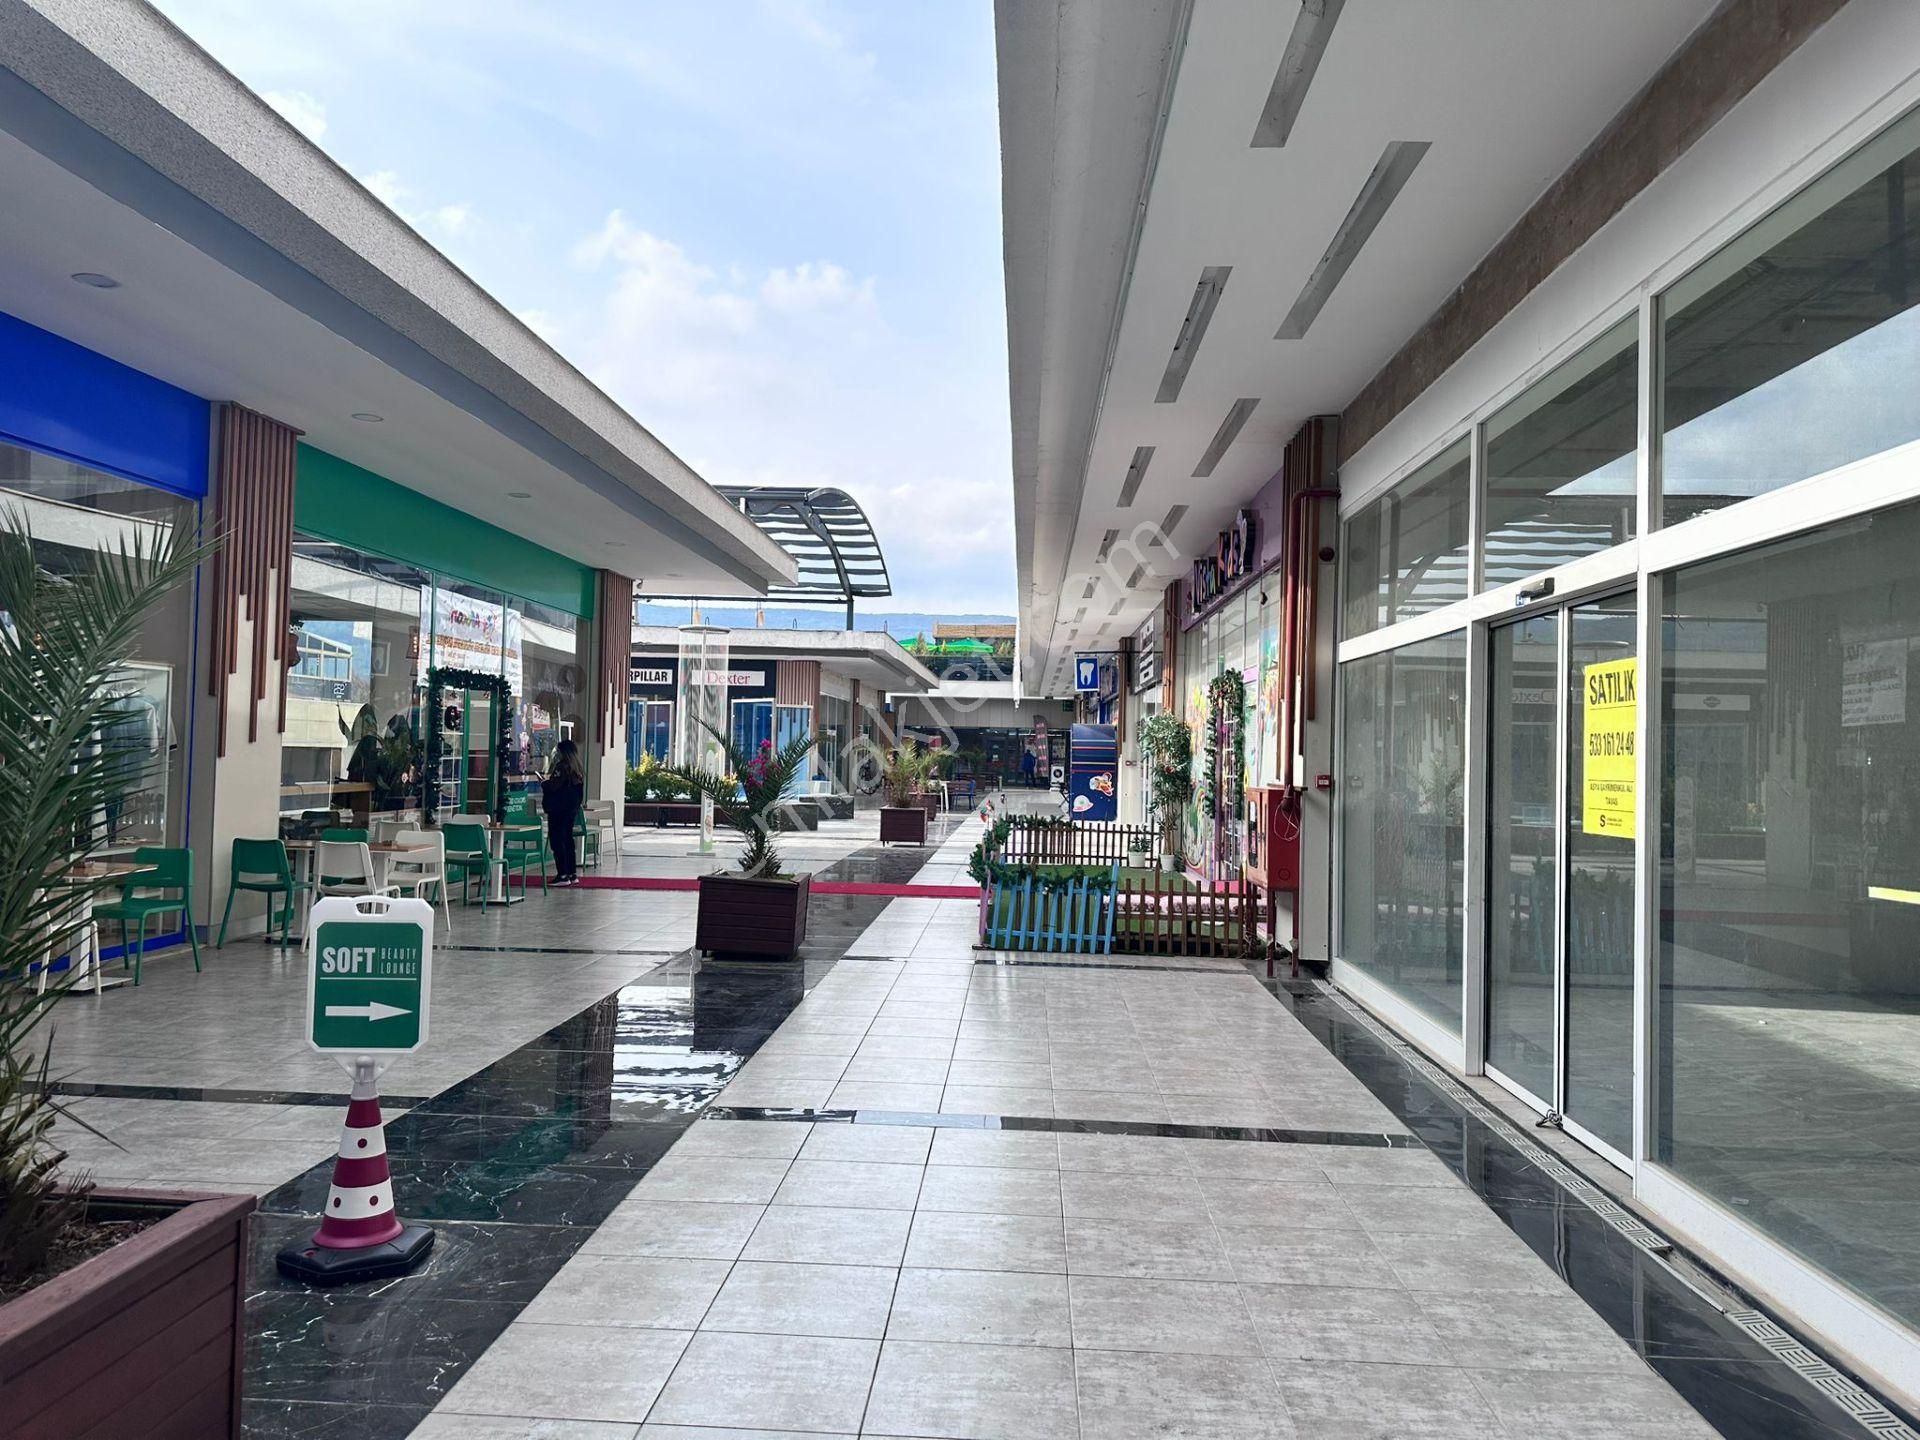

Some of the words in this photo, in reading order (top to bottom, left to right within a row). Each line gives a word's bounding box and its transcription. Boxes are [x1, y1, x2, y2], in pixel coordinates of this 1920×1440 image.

[707, 671, 751, 685] Dexter
[1589, 669, 1635, 705] SATILIK
[1589, 733, 1602, 756] 533
[1603, 732, 1615, 756] 161
[1616, 731, 1624, 756] 24
[1625, 731, 1635, 756] 48
[1599, 814, 1606, 828] S
[322, 946, 375, 974] SOFT
[381, 947, 417, 960] BEAUTY
[380, 962, 416, 975] LOUNGE
